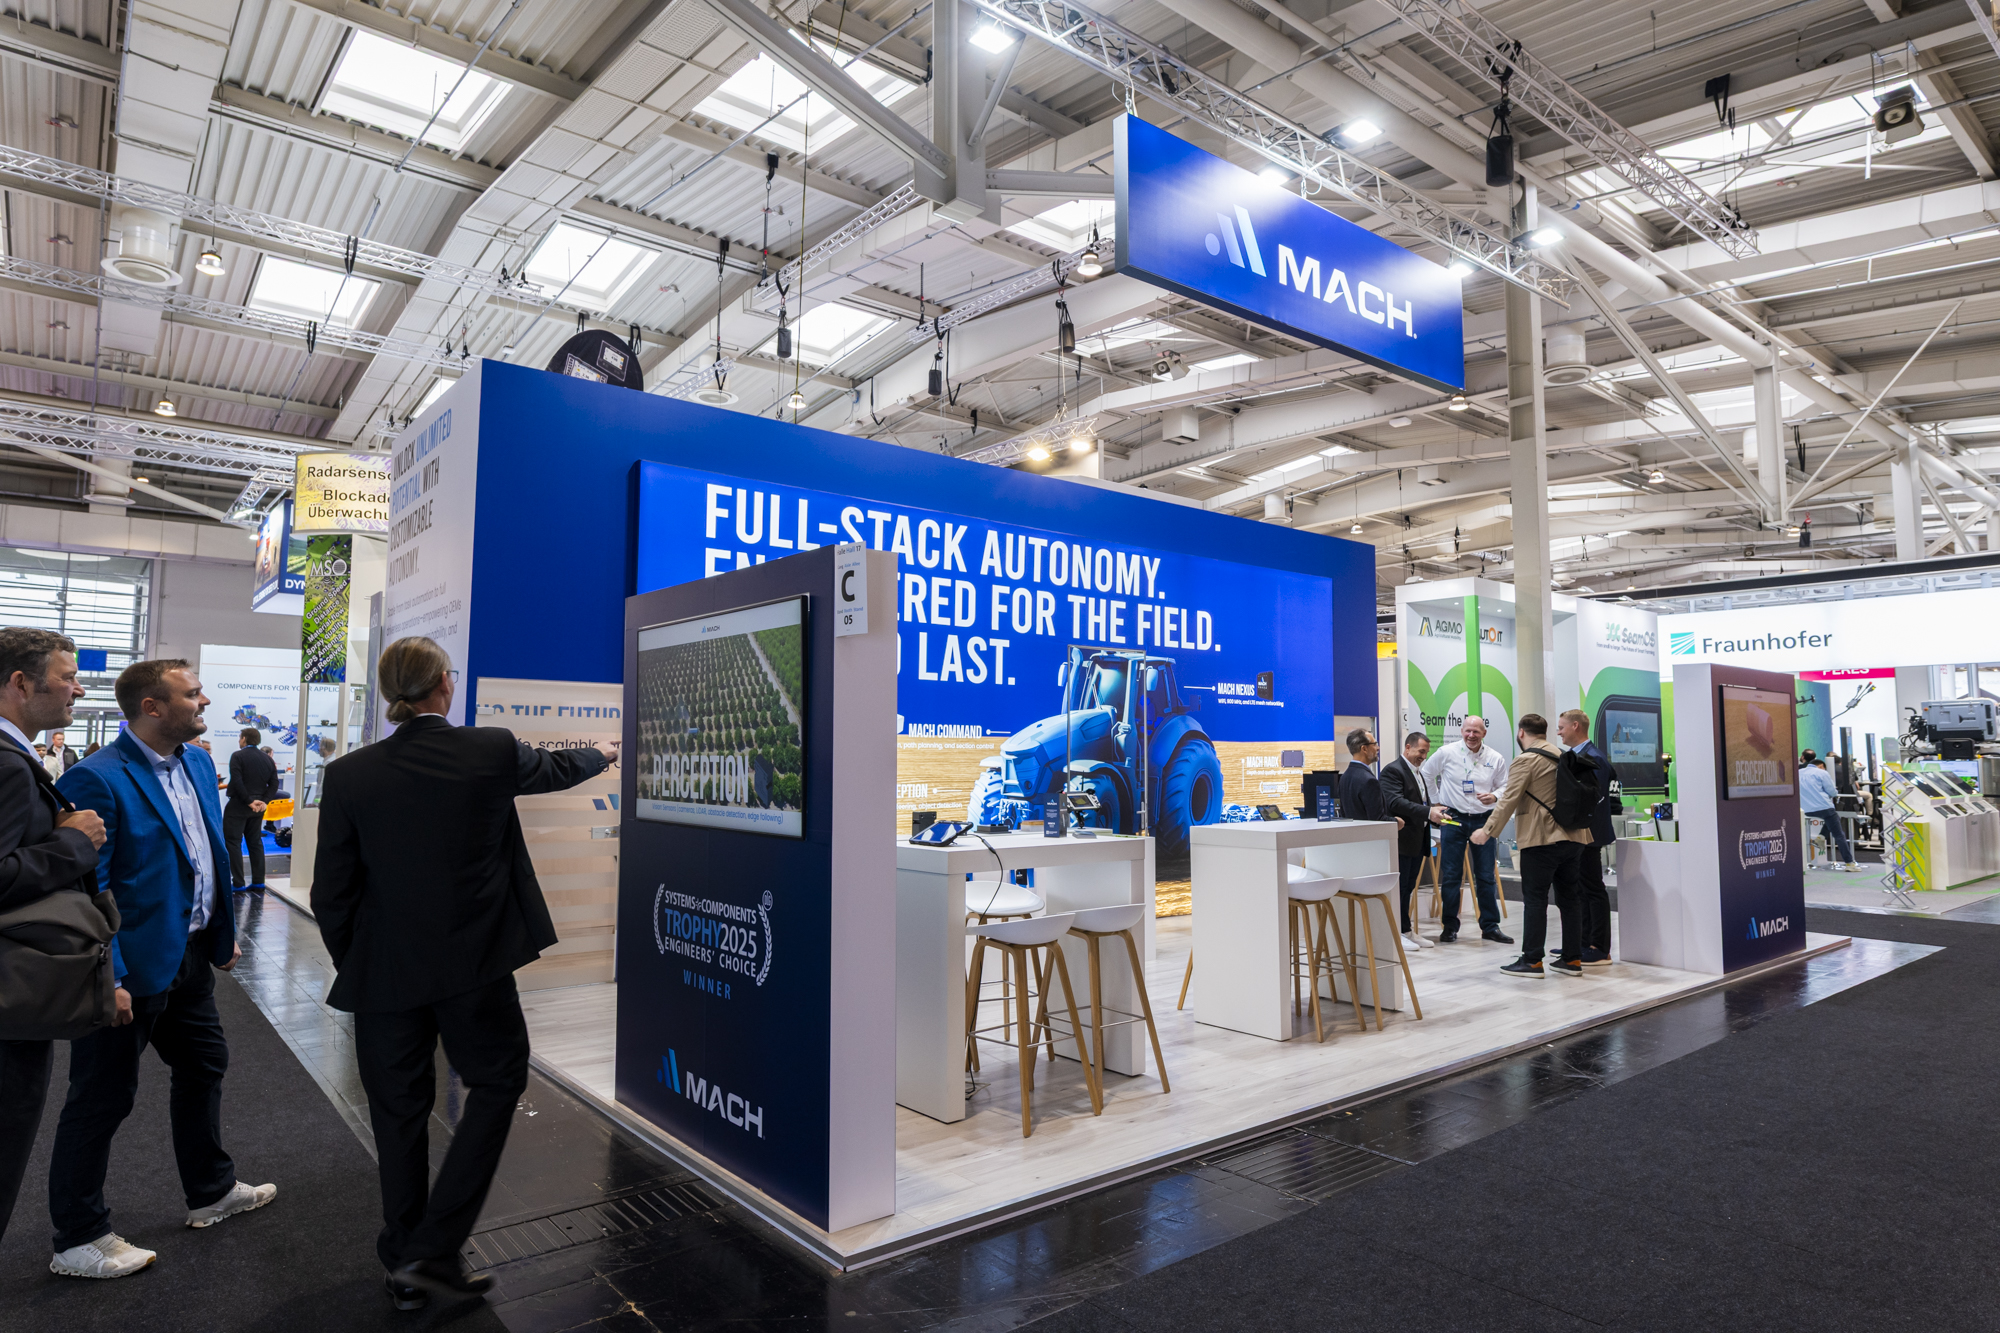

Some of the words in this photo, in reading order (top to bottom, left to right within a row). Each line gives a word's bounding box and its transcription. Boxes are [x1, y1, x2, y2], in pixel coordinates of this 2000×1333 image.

[1278, 243, 1413, 337] MACH
[394, 440, 415, 482] UNLOCK
[416, 408, 451, 462] UNLIMITED
[324, 490, 390, 503] Blockad
[392, 471, 420, 517] POTENTIAL
[423, 456, 439, 494] WITH
[390, 499, 433, 552] CUSTOMIZABLE
[706, 483, 968, 572] FULL-STACK
[980, 530, 1165, 600] AUTONOMY.
[388, 546, 419, 588] AUTONOMY.
[841, 570, 855, 602] C
[306, 597, 328, 620] Ground
[327, 580, 348, 600] Speed
[449, 599, 462, 614] OEMs
[314, 600, 340, 625] Distance
[844, 615, 853, 625] 05
[991, 584, 1056, 636] FOR
[1068, 595, 1127, 644] THE
[1137, 604, 1221, 652] FIELD.
[306, 636, 324, 656] Spray
[324, 619, 344, 640] quality
[307, 619, 332, 643] Material
[448, 621, 457, 635] and
[1435, 620, 1462, 634] AGMO
[304, 655, 318, 670] GPS
[318, 630, 346, 658] Antennas
[1702, 631, 1832, 654] Fraunhofer
[304, 667, 319, 681] GPS
[318, 644, 344, 670] Receiver
[918, 632, 1016, 686] LAST.
[218, 683, 272, 691] COMPONENTS
[1218, 682, 1235, 695] MACH
[1236, 683, 1255, 696] NEXUS
[908, 723, 935, 738] MACH
[937, 724, 982, 739] COMMAND
[1420, 712, 1445, 726] Seam
[1448, 713, 1462, 727] the
[918, 742, 943, 750] planning,
[1246, 756, 1263, 767] MACH
[1735, 760, 1778, 784] PERCEPTION
[652, 754, 748, 803] PERCEPTION
[897, 784, 928, 798] EPTION
[708, 808, 725, 817] obstacle
[748, 812, 760, 822] edge
[760, 813, 783, 824] following)
[918, 802, 936, 811] object
[1755, 868, 1775, 879] WINNER
[665, 890, 696, 910] SYSTEMS
[701, 898, 756, 924] COMPONENTS
[1760, 916, 1789, 938] MACH
[719, 953, 756, 978] CHOICE
[683, 969, 730, 1000] WINNER
[686, 1071, 763, 1138] MACH
